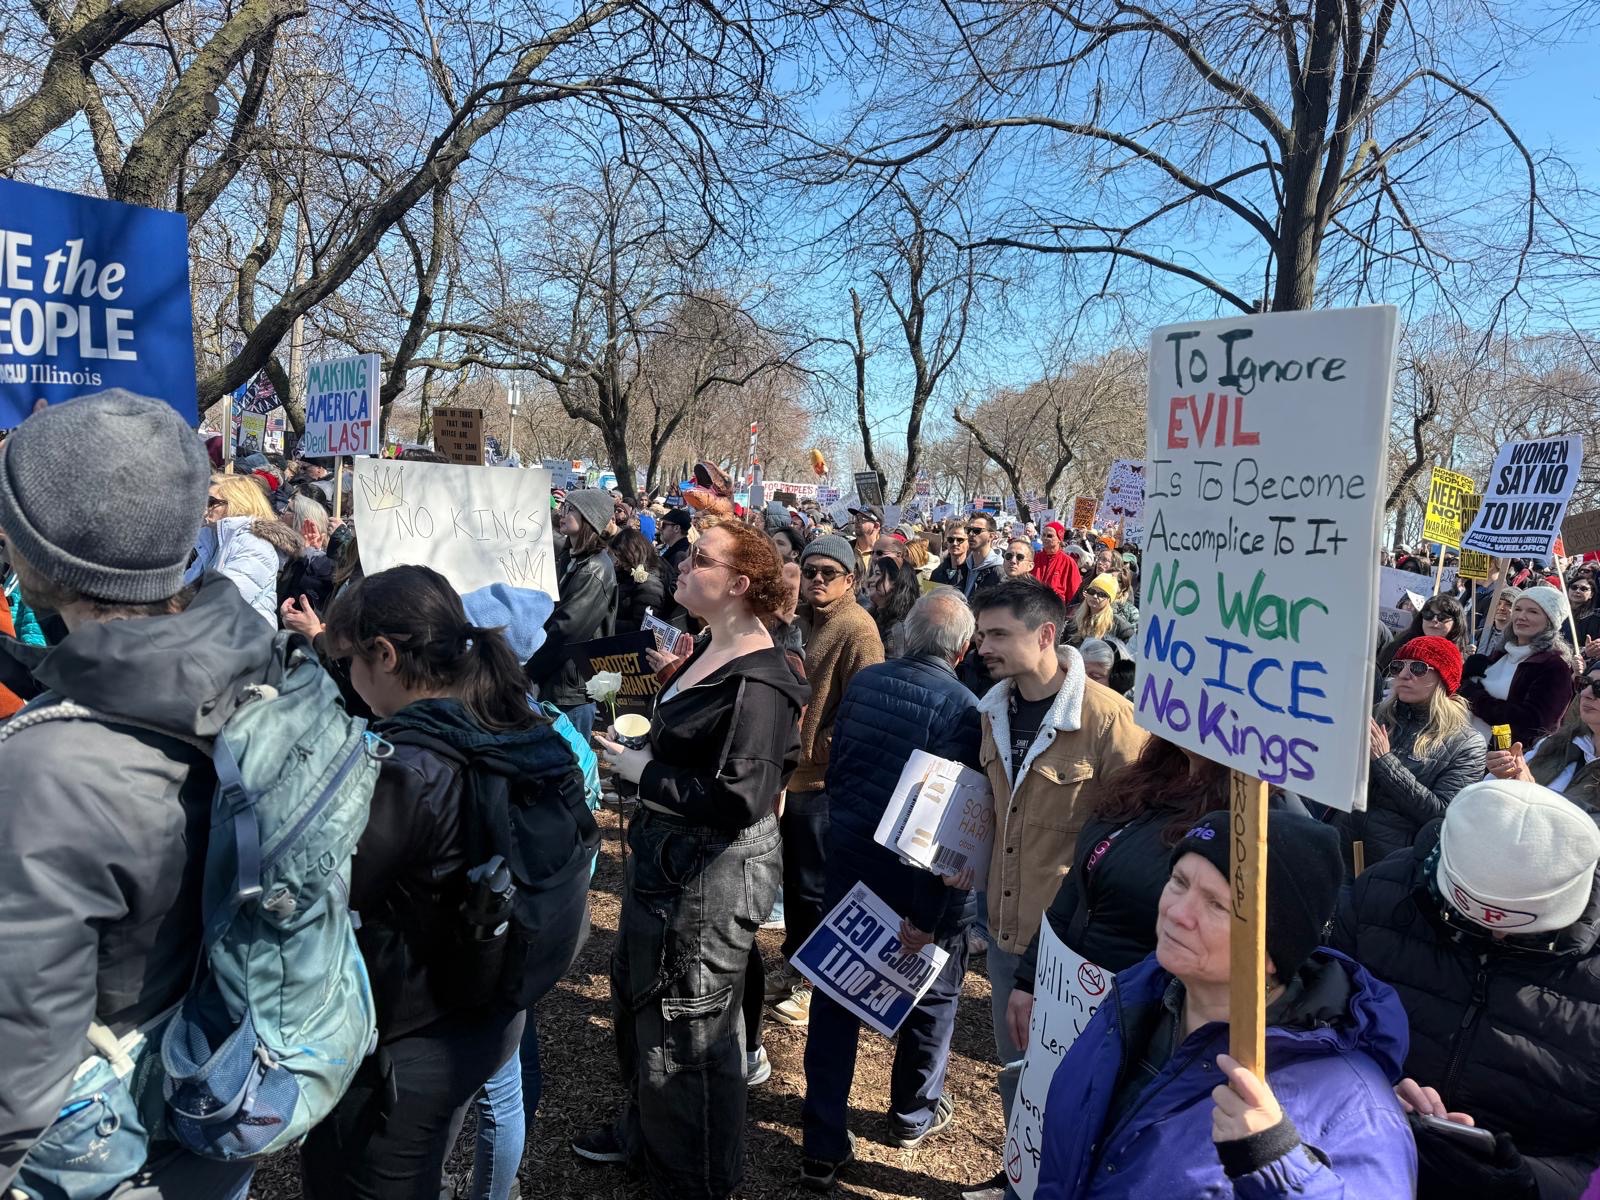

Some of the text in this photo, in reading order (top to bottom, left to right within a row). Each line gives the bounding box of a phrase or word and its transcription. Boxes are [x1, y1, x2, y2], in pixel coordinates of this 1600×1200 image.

[0, 229, 126, 300] E the
[30, 363, 102, 386] Illinois
[307, 359, 368, 394] MAKING
[1165, 328, 1347, 395] To Ignore
[307, 390, 369, 423] AMERICA
[1167, 392, 1260, 450] EVIL
[328, 420, 372, 454] LAST
[1509, 440, 1569, 465] WOMEN
[1148, 458, 1366, 505] Is To Become
[1433, 467, 1474, 485] MONEY FOR
[1433, 473, 1473, 492] PEOPLE'S
[1496, 464, 1569, 495] SAY NO
[1431, 481, 1470, 510] NEED
[393, 506, 544, 543] NO KINGS
[1425, 519, 1440, 534] WAR
[1479, 502, 1511, 531] TO
[1508, 502, 1562, 531] WAR!
[1147, 508, 1348, 562] Accomplice To It
[1471, 532, 1489, 543] PARTY
[1147, 558, 1329, 643] No War
[590, 652, 641, 674] PROTECT
[1144, 615, 1334, 724] No ICE
[1139, 673, 1319, 784] No Kings
[963, 799, 993, 823] SOO
[832, 900, 885, 953] ICE!
[817, 942, 902, 1017] ICE OUT!
[1041, 1012, 1076, 1056] Len
